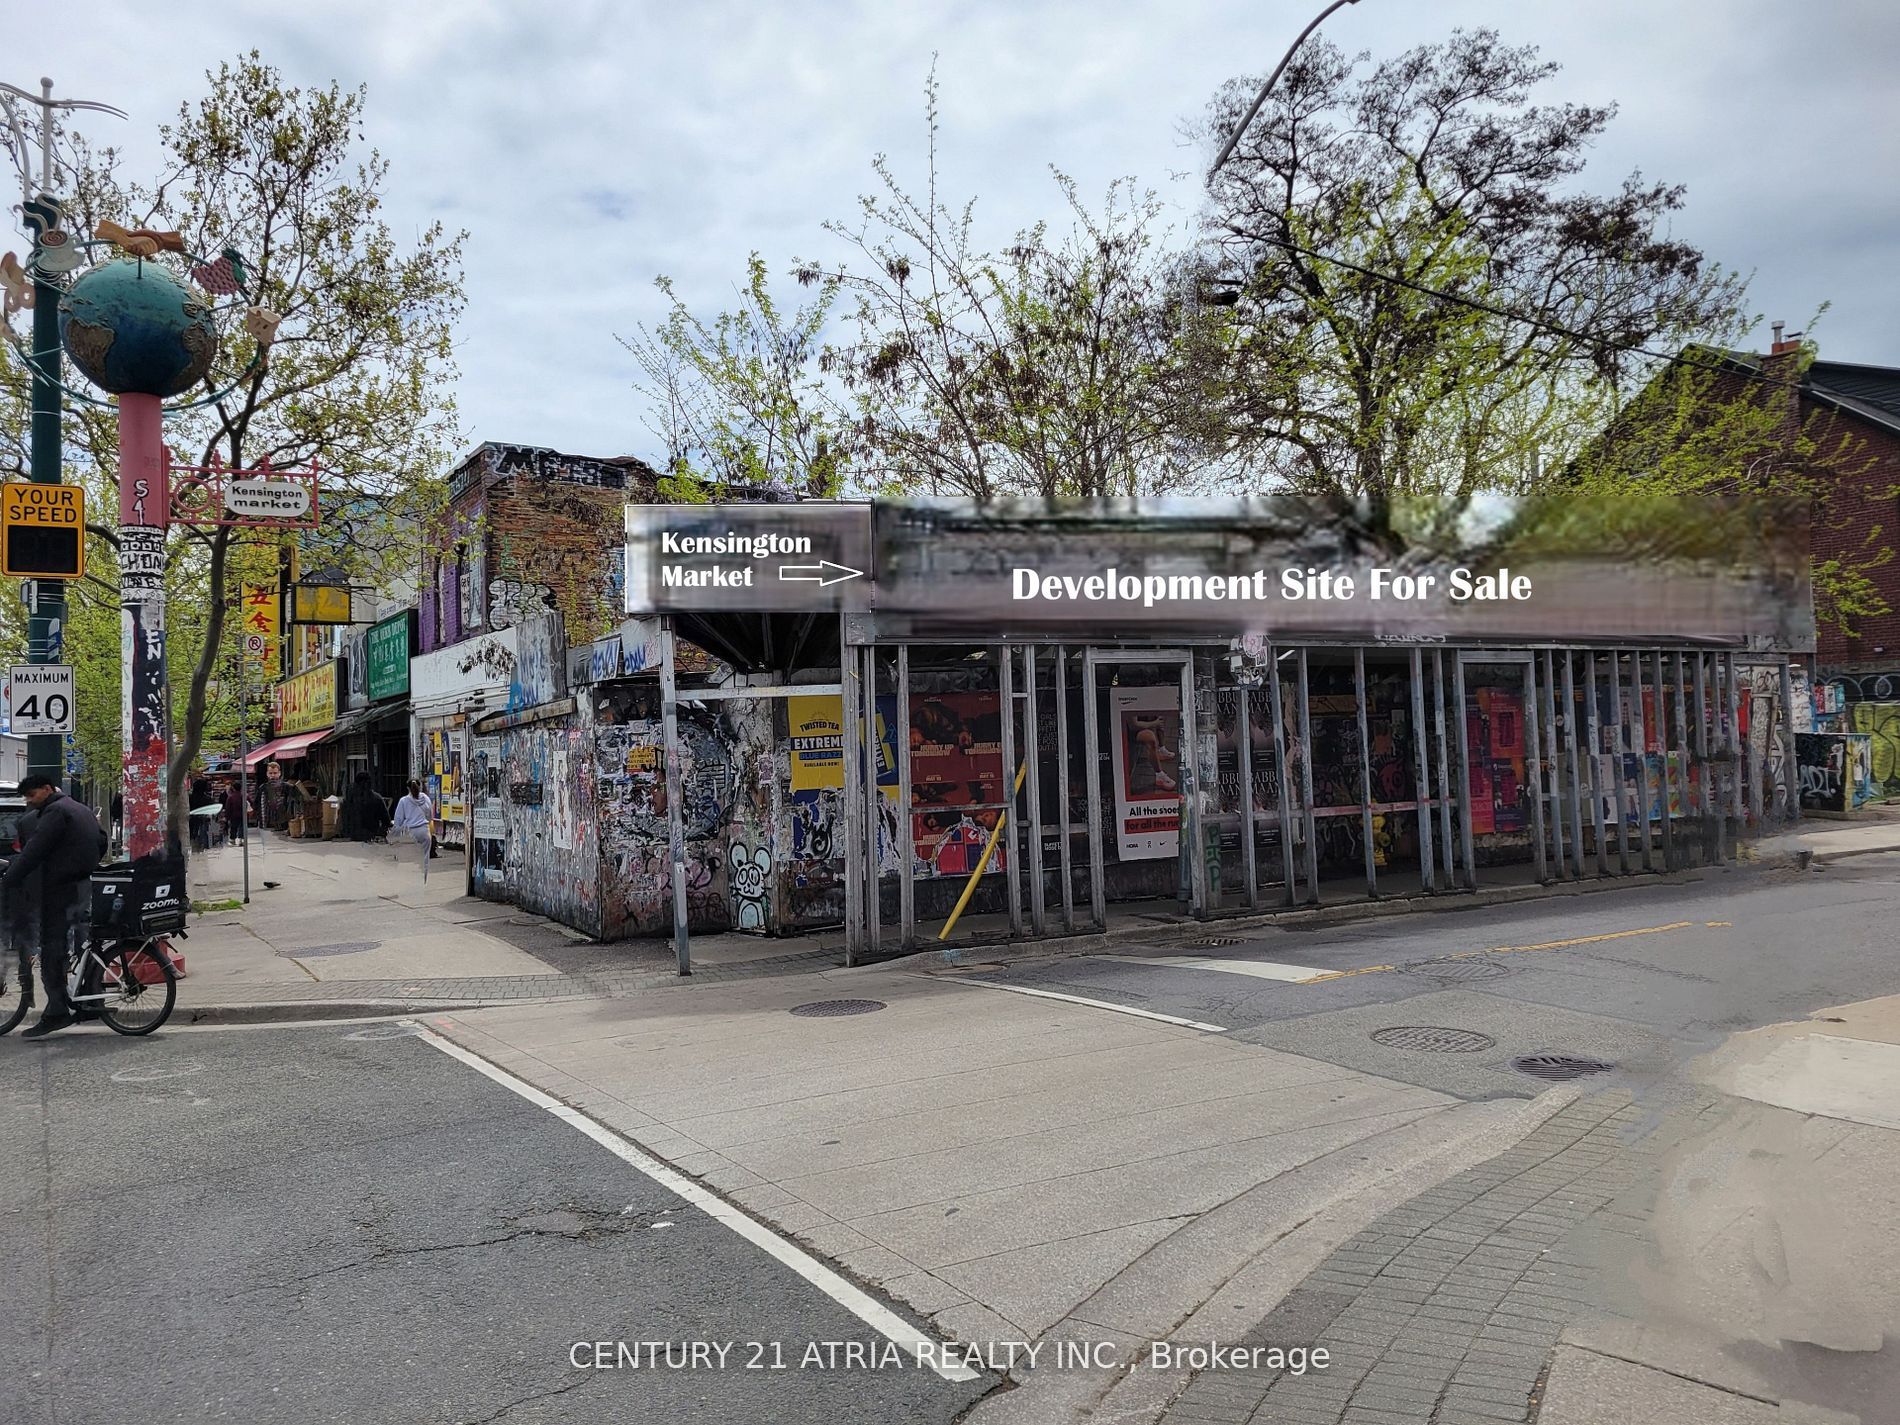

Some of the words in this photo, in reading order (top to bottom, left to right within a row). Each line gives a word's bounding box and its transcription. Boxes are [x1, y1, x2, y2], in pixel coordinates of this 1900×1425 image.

[15, 488, 74, 506] YOUR
[232, 486, 303, 500] Kensington
[234, 499, 302, 510] market
[10, 505, 77, 523] SPEED
[15, 673, 69, 684] MAXIMUM
[15, 694, 69, 724] 40
[800, 721, 827, 732] TWISTED
[828, 721, 840, 731] TEA
[794, 736, 844, 750] EXTREM
[800, 752, 820, 760] BLUE
[1129, 806, 1142, 817] All
[1142, 806, 1158, 816] the
[1126, 821, 1139, 830] for
[1140, 820, 1152, 829] all
[1153, 819, 1166, 828] the
